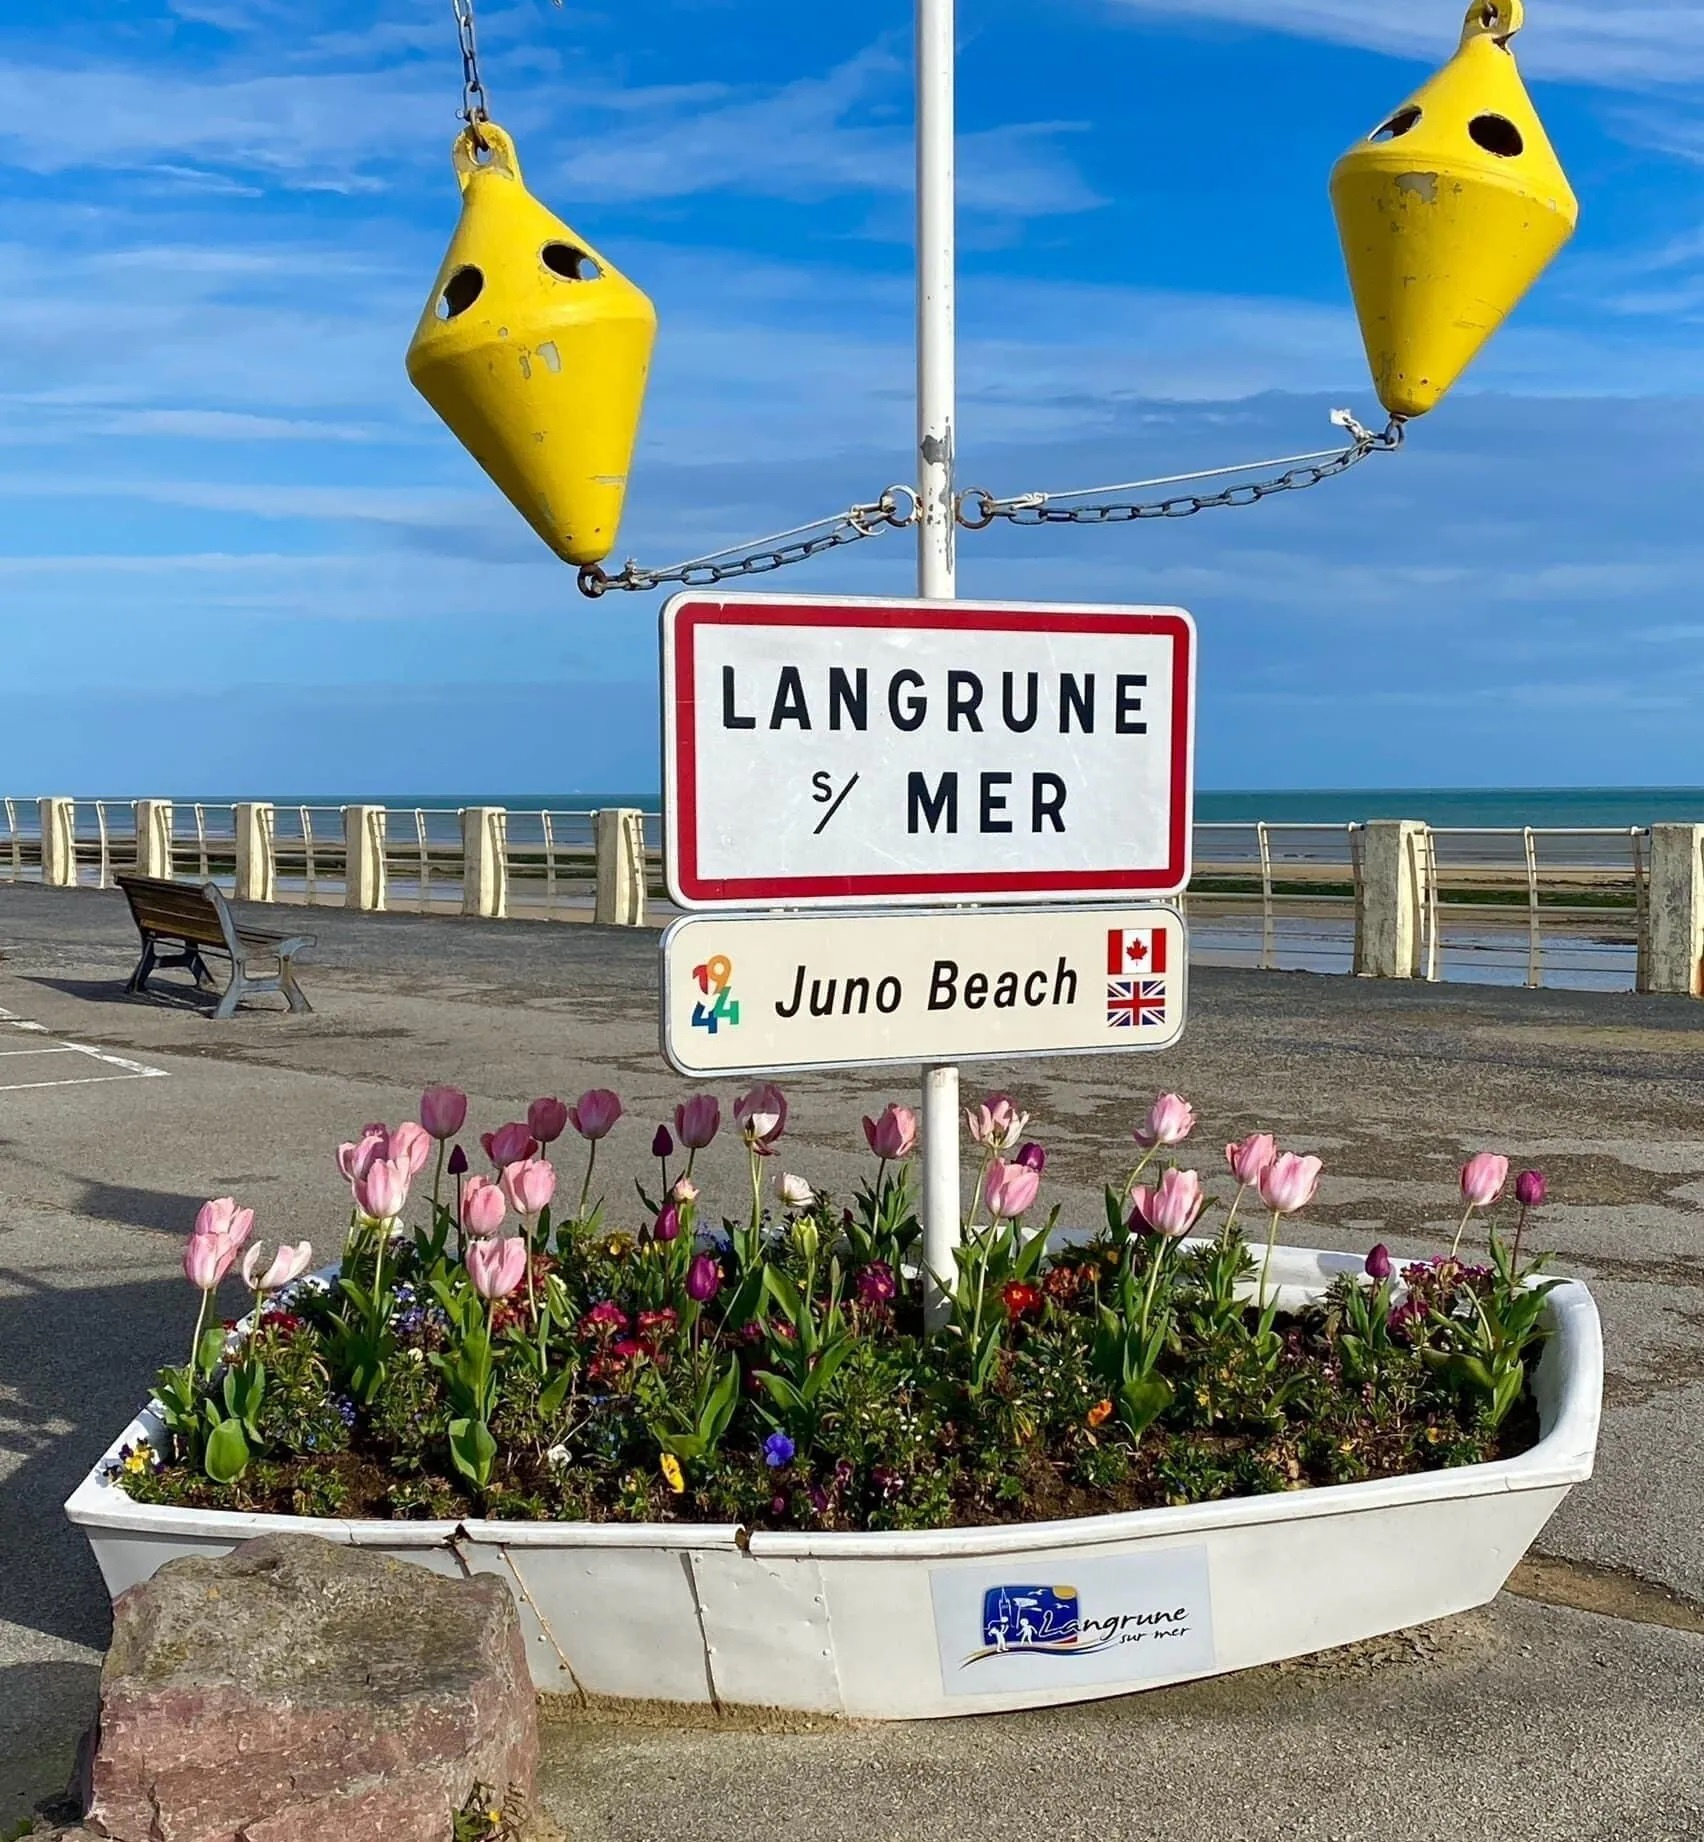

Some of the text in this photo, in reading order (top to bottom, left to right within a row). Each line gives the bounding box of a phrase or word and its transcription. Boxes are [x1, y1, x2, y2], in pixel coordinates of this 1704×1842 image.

[721, 665, 1148, 735] LANGRUNE
[906, 771, 1067, 834] MER
[775, 957, 1077, 1018] Juno Beach
[1039, 1607, 1189, 1641] Langrune
[1120, 1626, 1191, 1644] sur mer
